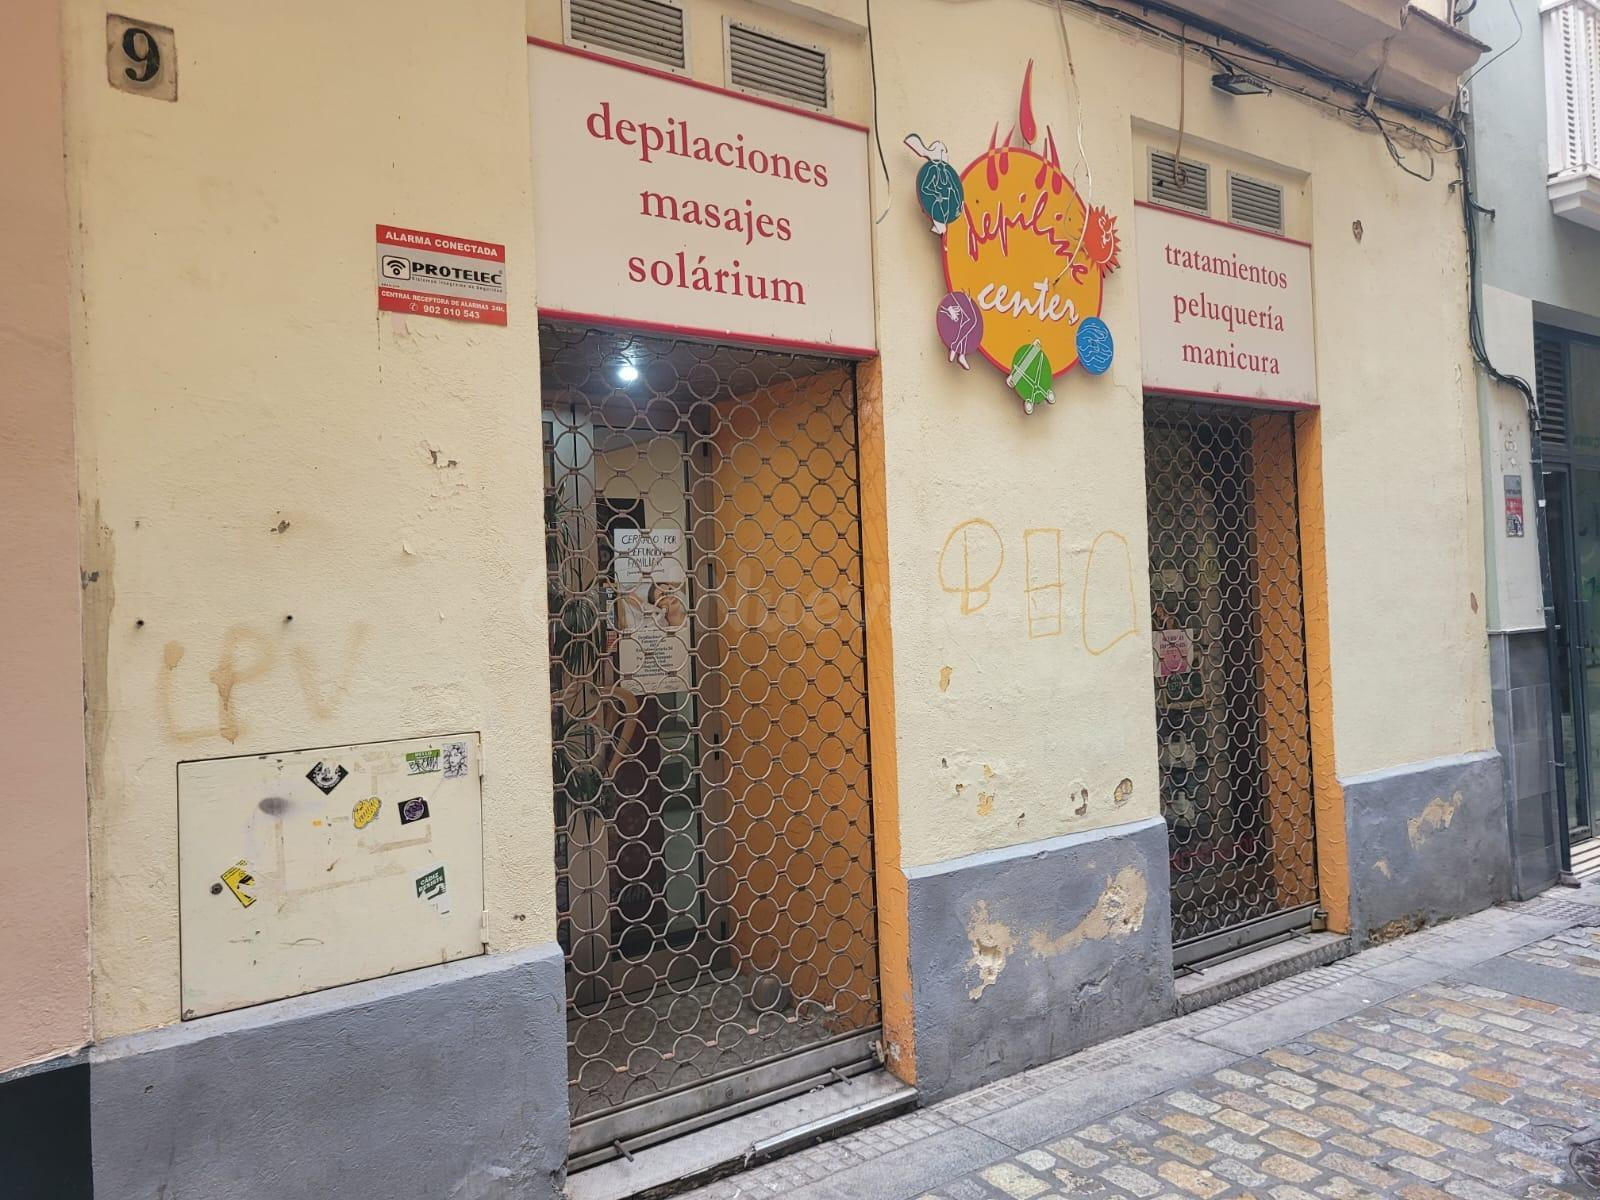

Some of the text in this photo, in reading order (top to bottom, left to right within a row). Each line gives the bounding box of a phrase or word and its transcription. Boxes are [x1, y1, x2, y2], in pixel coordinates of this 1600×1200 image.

[123, 28, 160, 82] 9
[586, 102, 829, 187] depilaciones
[639, 190, 792, 245] masajes
[385, 231, 499, 257] ALARMA CONECTADA
[412, 262, 502, 284] PROTELEC
[628, 251, 806, 305] solárium
[1164, 243, 1288, 289] tratamientos
[381, 290, 411, 300] CENTRAL
[413, 294, 449, 305] RECEPTORA
[460, 301, 489, 310] ALARMAS
[423, 304, 480, 319] 902 010 543
[977, 277, 1080, 326] center
[1173, 292, 1284, 333] peluquería
[1182, 343, 1280, 375] manicura
